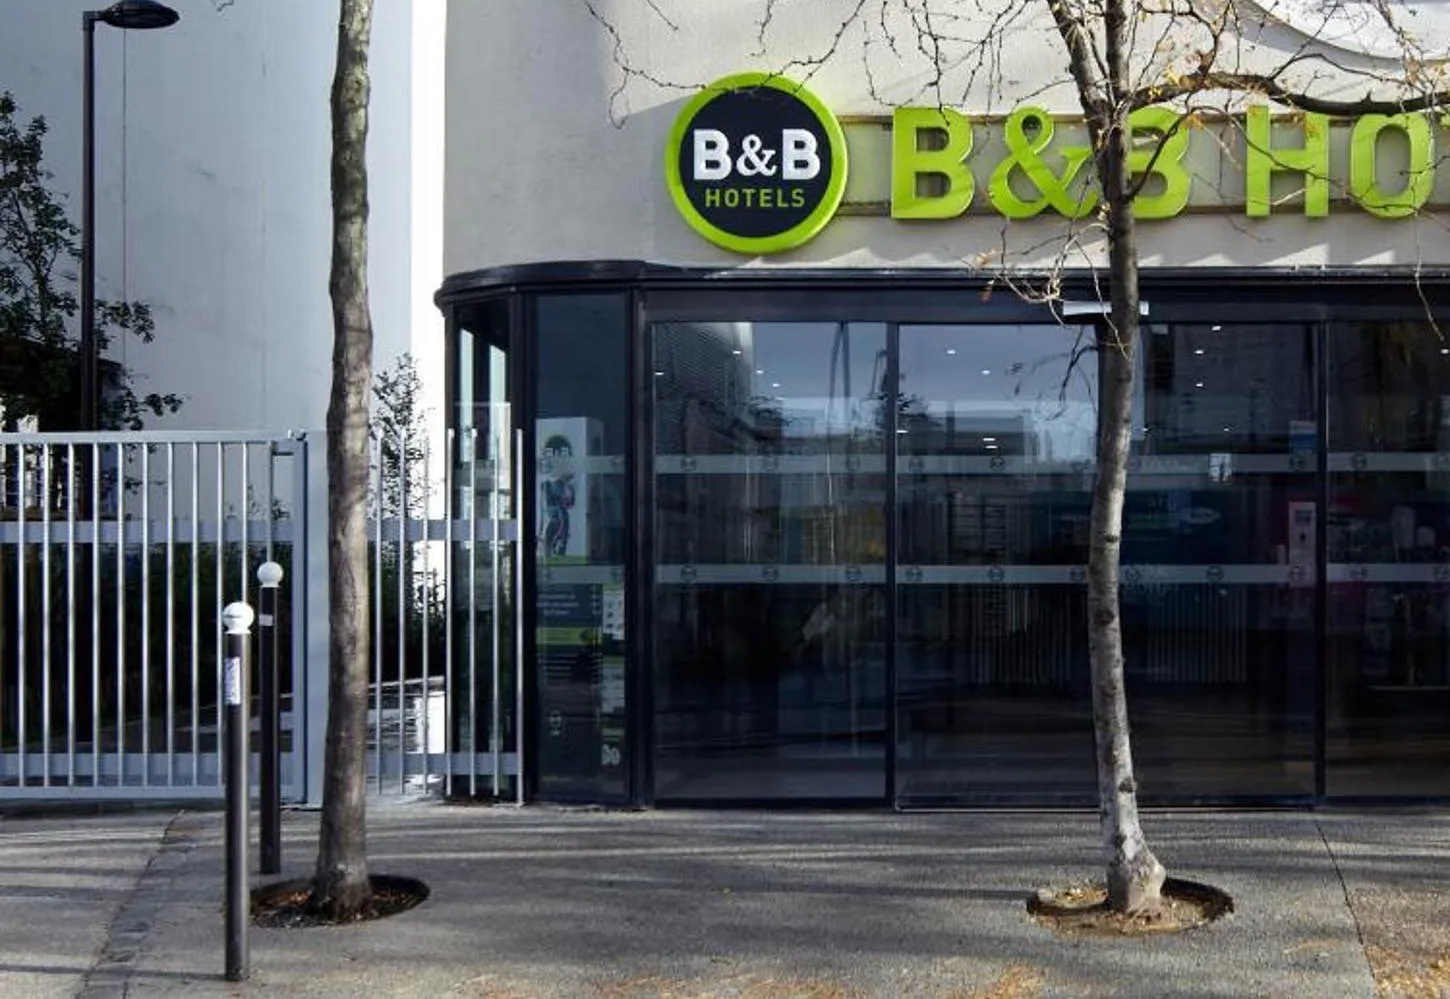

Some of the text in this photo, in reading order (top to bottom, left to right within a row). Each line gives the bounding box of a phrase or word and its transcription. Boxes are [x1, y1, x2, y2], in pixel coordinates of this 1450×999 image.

[693, 128, 821, 181] B&B
[892, 106, 1192, 220] B&B
[704, 187, 806, 208] HOTELS
